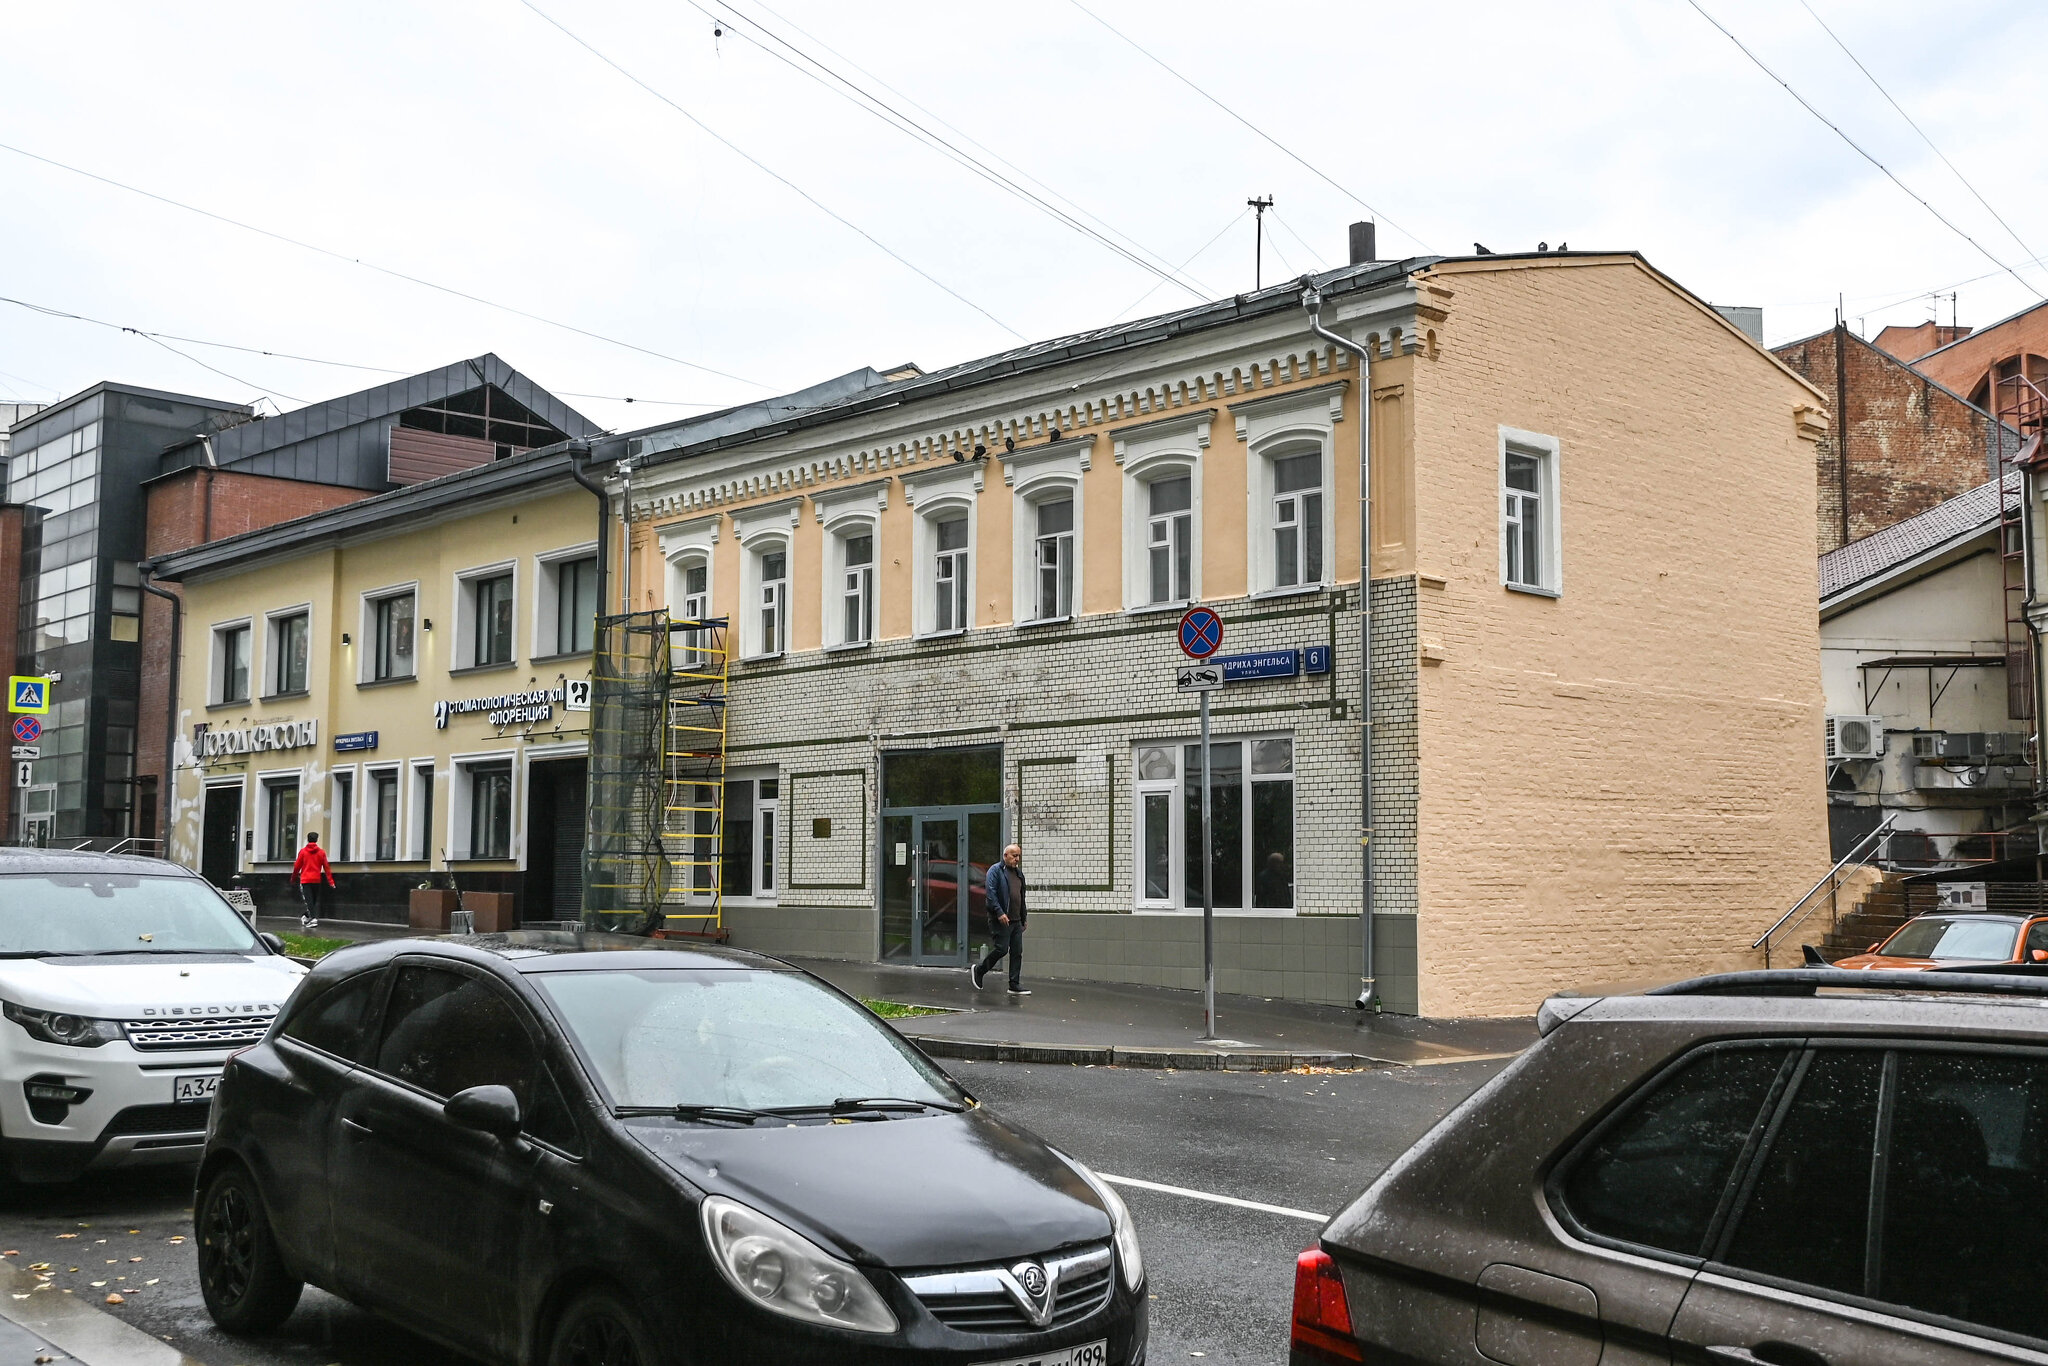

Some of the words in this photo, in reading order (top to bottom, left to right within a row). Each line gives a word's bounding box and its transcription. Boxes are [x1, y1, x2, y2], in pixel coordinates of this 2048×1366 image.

[1222, 660, 1251, 671] ИДРИХА
[1252, 656, 1290, 668] ЭНГЕЛЬСА
[1310, 651, 1318, 665] 6
[449, 689, 545, 714] СТОМАТОЛОГИЧЕСКАЯ
[488, 704, 549, 725] ФЛОРЕНЦИЯ
[203, 729, 252, 756] ГОРОД
[249, 719, 318, 752] КРАСОТЫ
[368, 734, 373, 743] 6
[181, 1077, 217, 1098] А34
